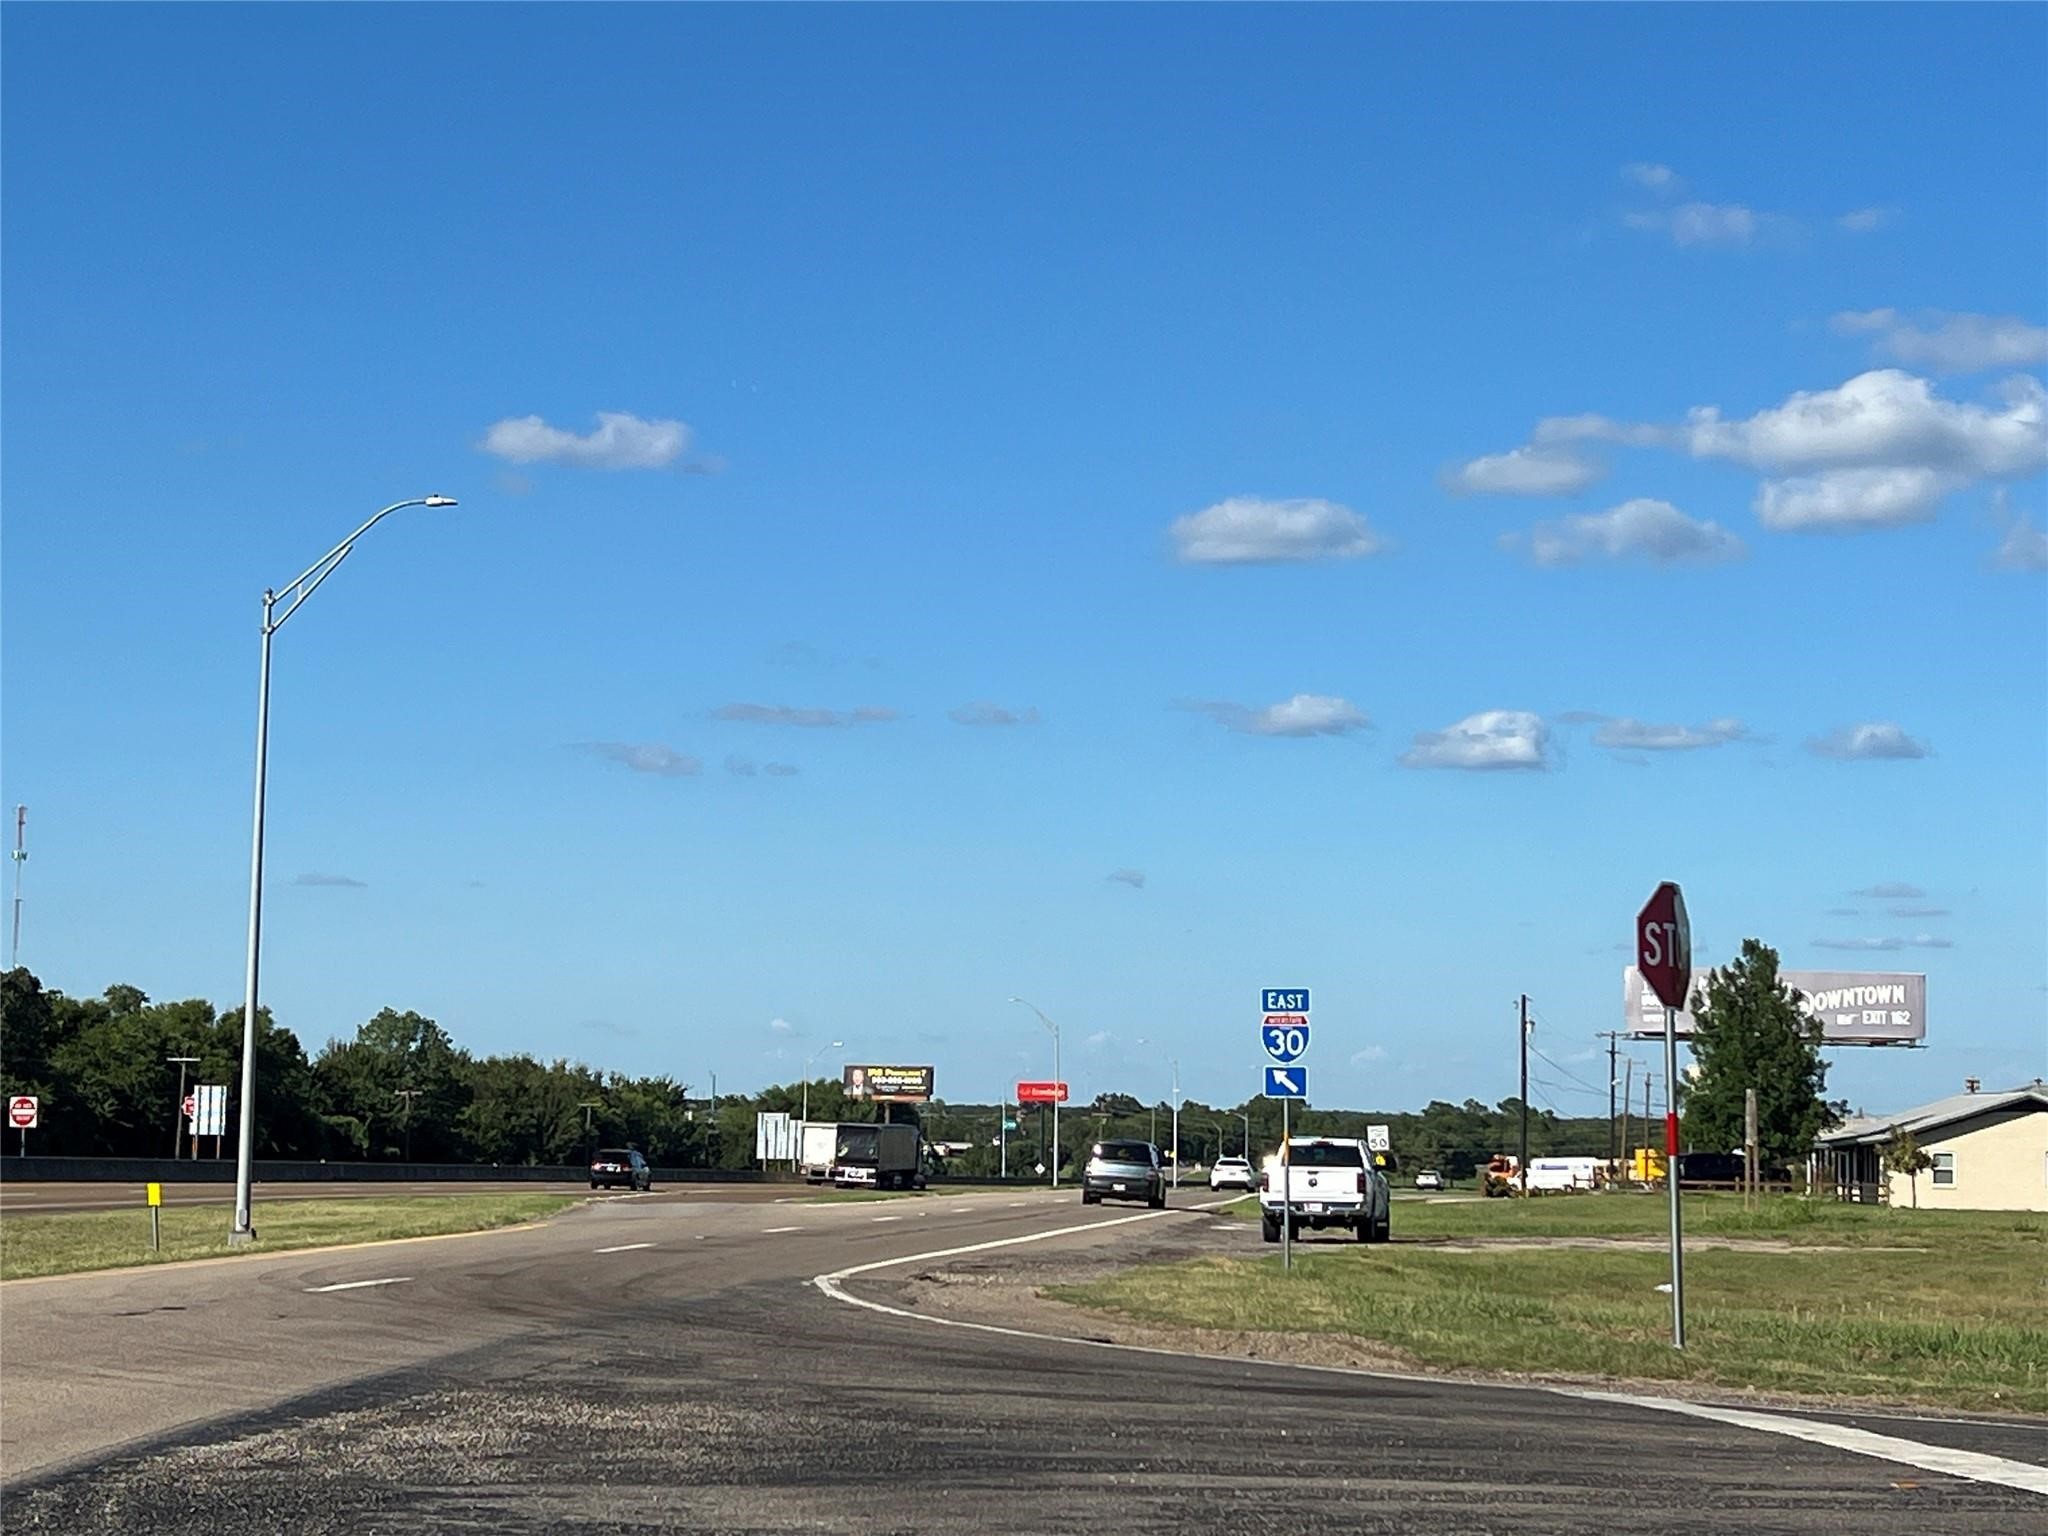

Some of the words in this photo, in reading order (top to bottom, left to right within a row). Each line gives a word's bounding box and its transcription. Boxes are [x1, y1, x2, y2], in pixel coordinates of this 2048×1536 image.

[1267, 992, 1303, 1009] EAST
[1797, 985, 1905, 1018] DOWNTOWN
[1862, 1010, 1888, 1025] EXIT
[1269, 1030, 1304, 1055] 30
[1370, 1138, 1387, 1148] 50
